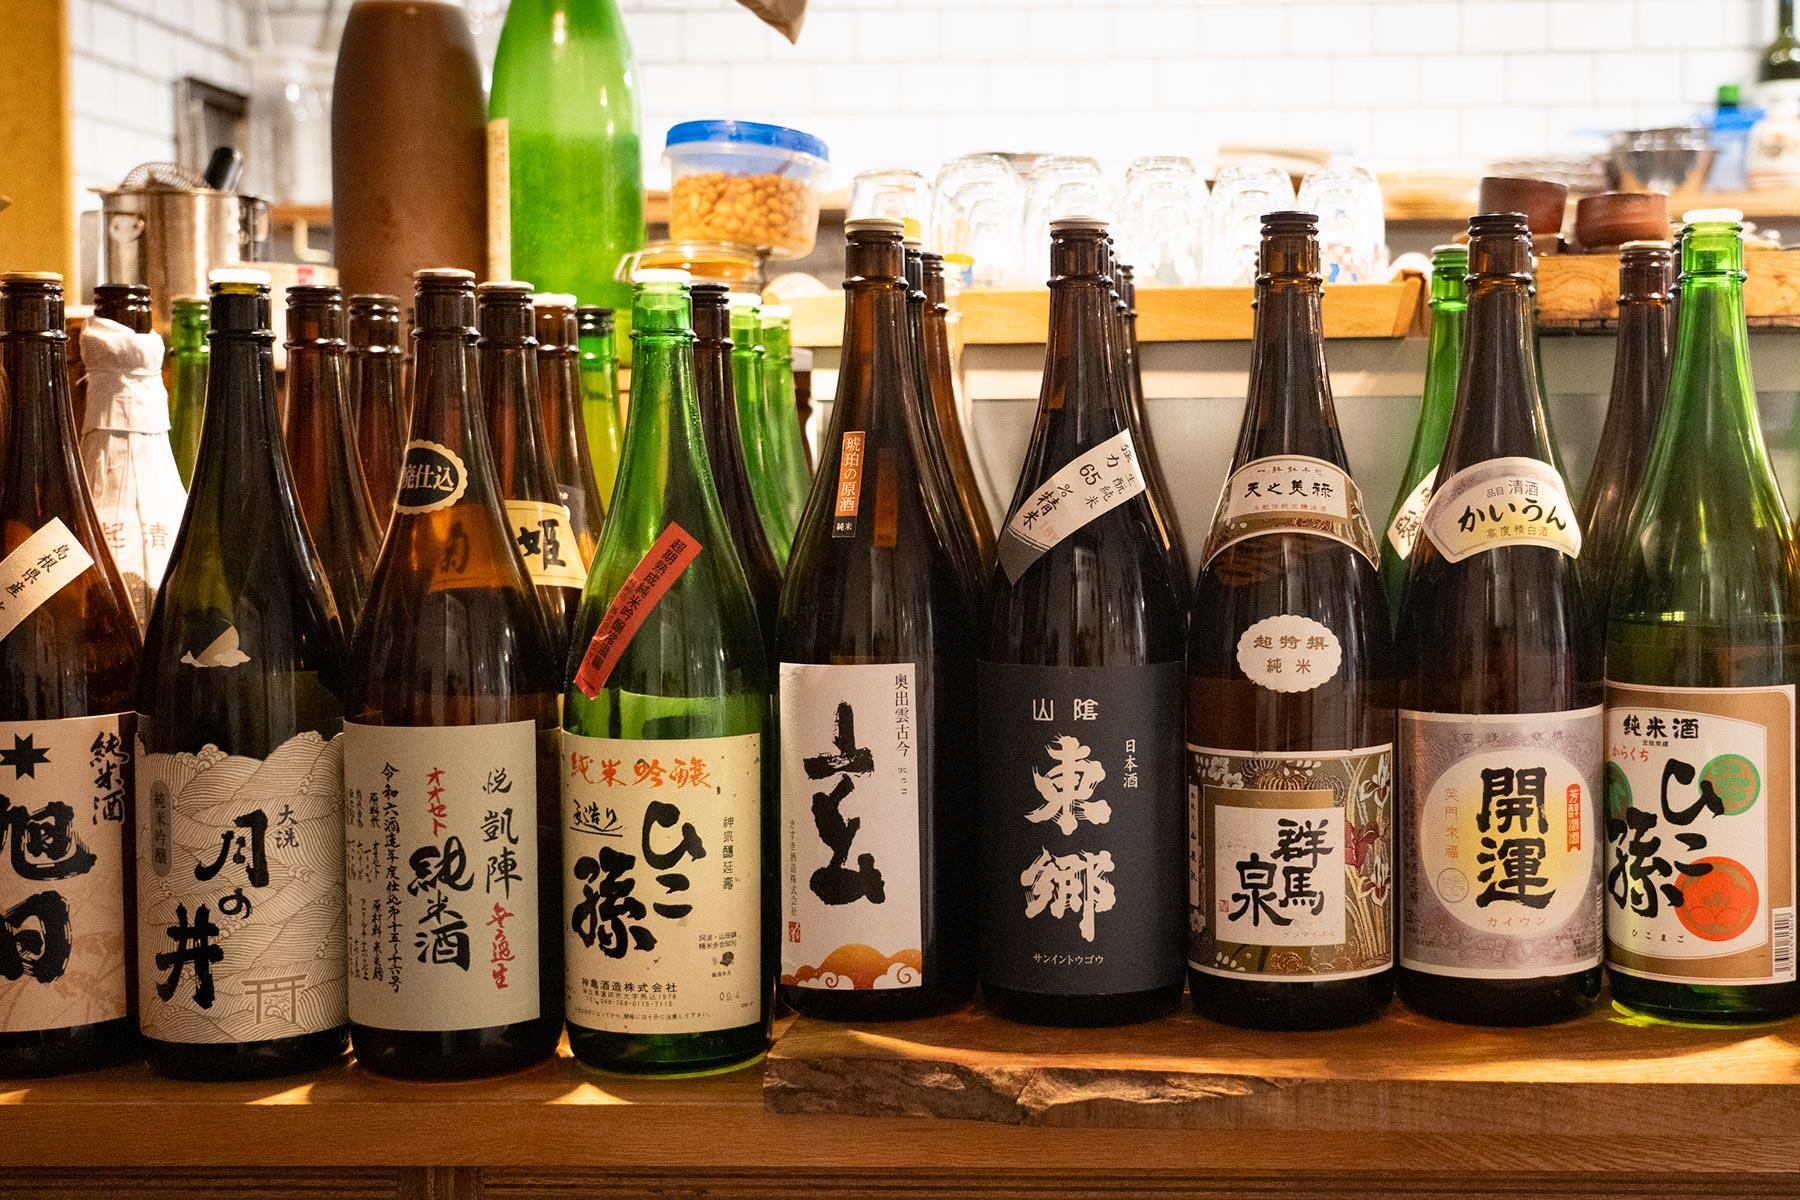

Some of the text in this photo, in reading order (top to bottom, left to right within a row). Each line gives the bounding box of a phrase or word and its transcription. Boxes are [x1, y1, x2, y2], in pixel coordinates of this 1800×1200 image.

[840, 436, 860, 511] 琥珀の原酒
[1245, 480, 1333, 498] 天之美禄
[1509, 480, 1538, 496] 清酒
[836, 522, 852, 531] 純米
[1458, 498, 1566, 532] かいうん
[1254, 635, 1328, 650] 超特撰
[1267, 658, 1311, 674] 純米
[895, 673, 910, 757] 奥出雲古今
[1623, 714, 1699, 739] 純米酒
[571, 751, 712, 789] 純米吟醸
[1124, 739, 1138, 788] 日本酒
[1612, 745, 1648, 762] からくち
[90, 731, 130, 825] 純米酒
[426, 767, 447, 837] オオセト
[1020, 733, 1116, 942] 東郷
[1476, 767, 1556, 909] 開運
[155, 808, 269, 1010] 月の井
[407, 835, 475, 972] 純米酒
[1487, 916, 1546, 928] カイウン
[1033, 953, 1104, 965] サンイントウゴウ
[582, 978, 677, 993] 神亀酒造株式会社
